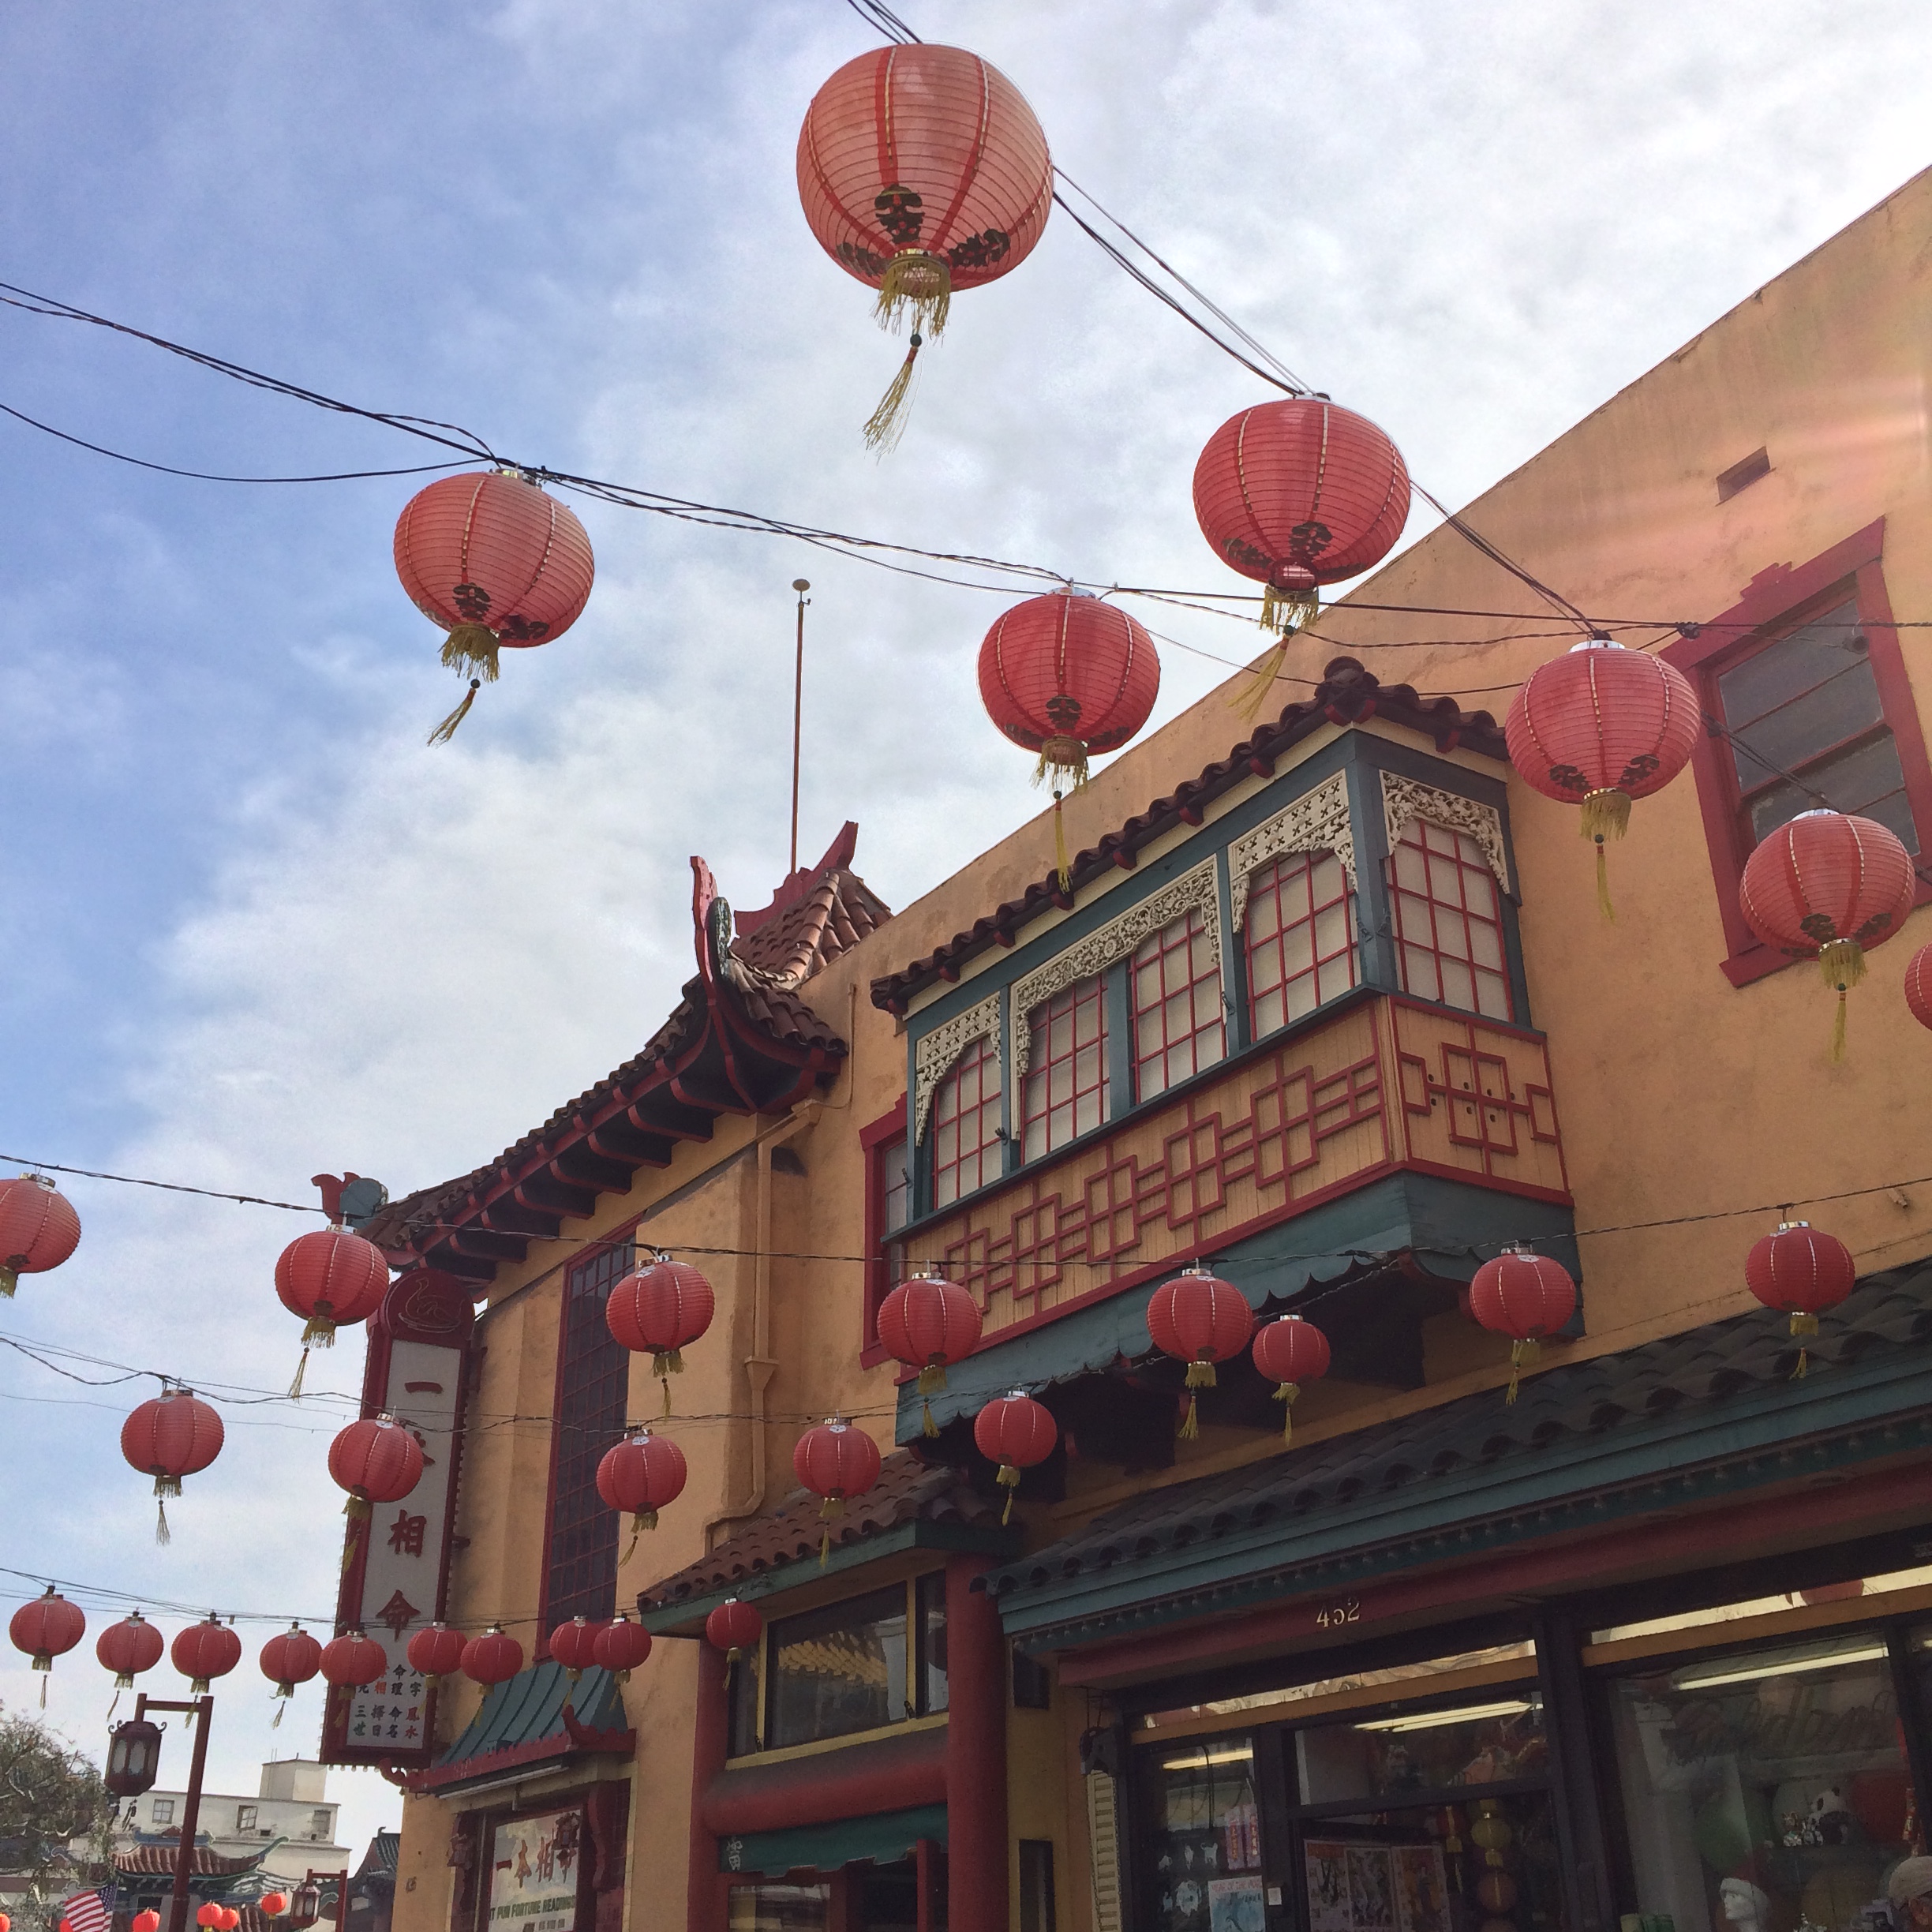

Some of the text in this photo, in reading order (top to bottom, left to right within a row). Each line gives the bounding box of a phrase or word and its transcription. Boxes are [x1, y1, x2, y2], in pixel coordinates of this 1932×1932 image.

[376, 1380, 443, 1642] 一相命
[1316, 1597, 1360, 1627] 452
[511, 1900, 541, 1918] FORTUNE
